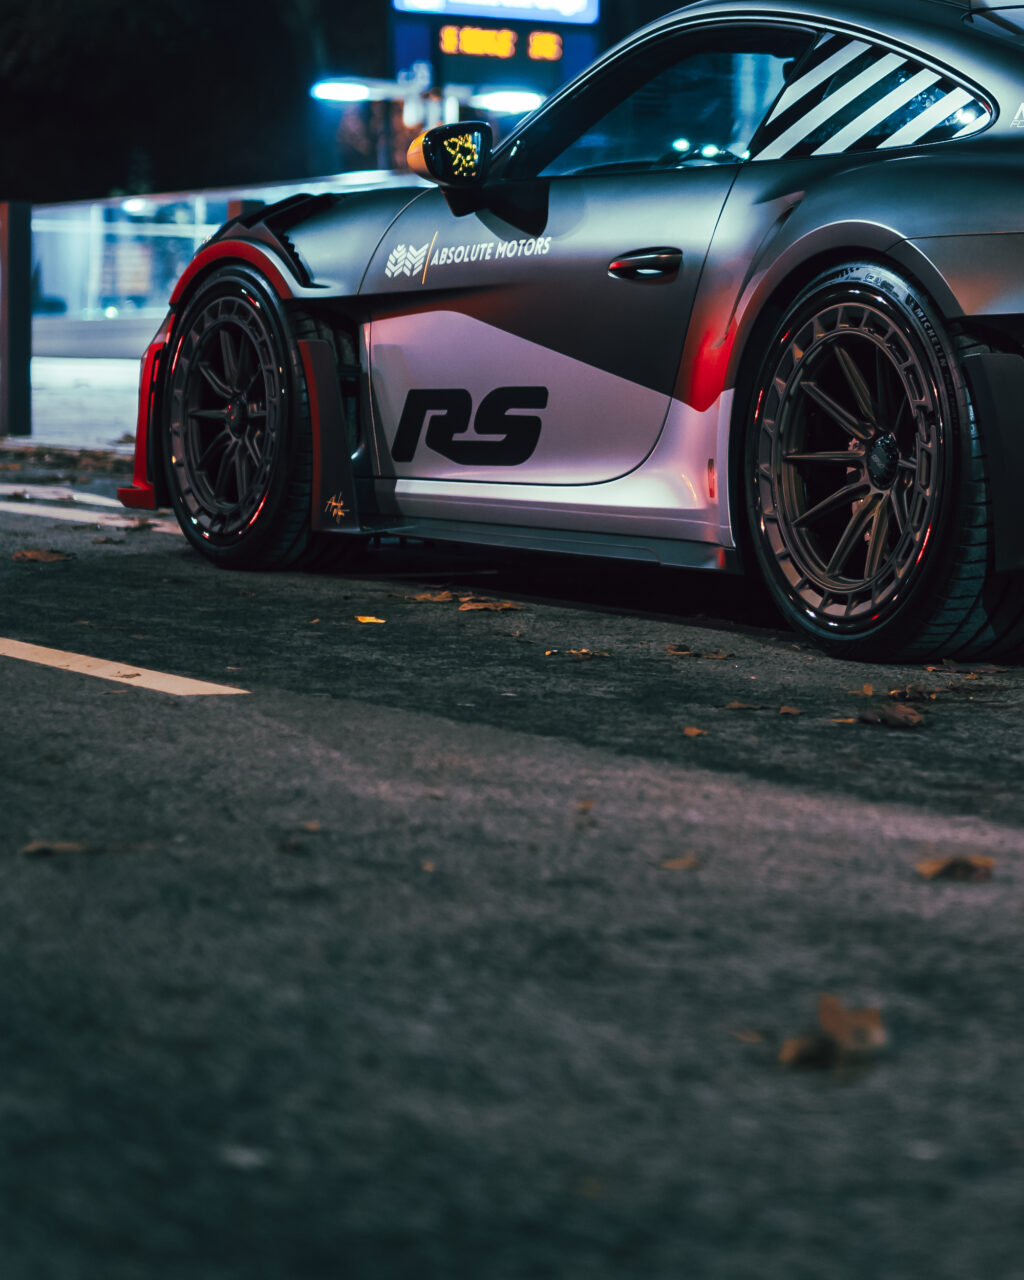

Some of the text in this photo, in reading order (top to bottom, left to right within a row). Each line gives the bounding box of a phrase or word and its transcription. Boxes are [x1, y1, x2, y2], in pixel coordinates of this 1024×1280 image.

[430, 236, 553, 266] ABSOLUTE MOTORS
[914, 307, 948, 368] MICHELIN
[391, 386, 549, 466] RS
